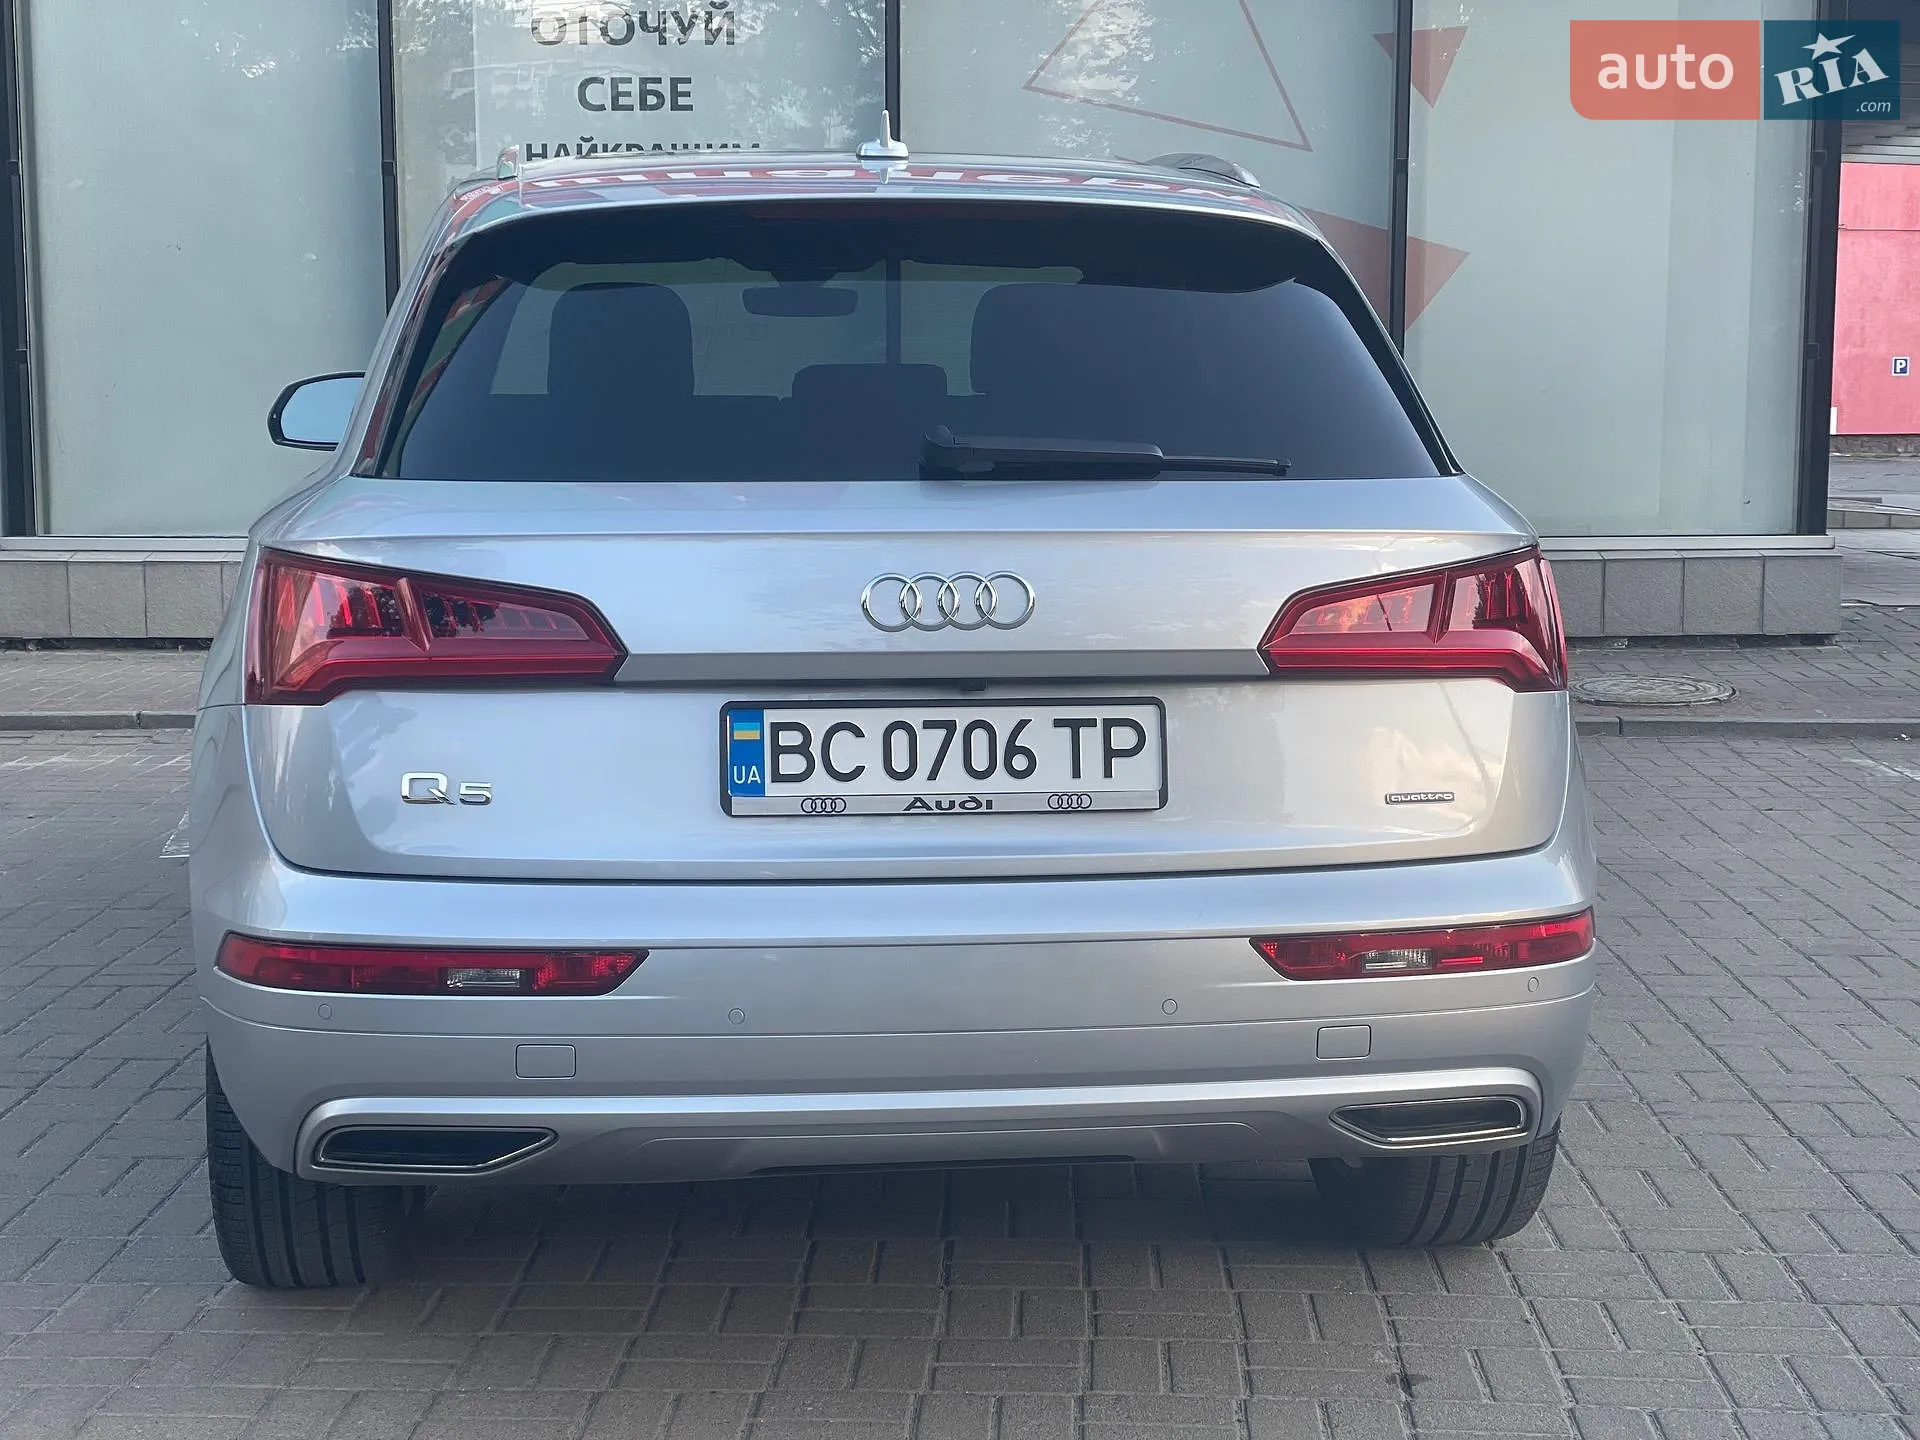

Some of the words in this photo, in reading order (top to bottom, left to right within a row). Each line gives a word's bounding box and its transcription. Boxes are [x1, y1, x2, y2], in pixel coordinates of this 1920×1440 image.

[531, 0, 735, 46] ОТОЧУЙ
[577, 76, 694, 112] СЕБЕ
[1896, 359, 1907, 373] P
[770, 720, 867, 783] BC
[882, 718, 1037, 781] 0706
[1053, 717, 1147, 779] TP
[733, 765, 761, 784] UA
[401, 772, 492, 806] Q5
[1390, 793, 1453, 803] quattro
[902, 796, 994, 811] Audi
